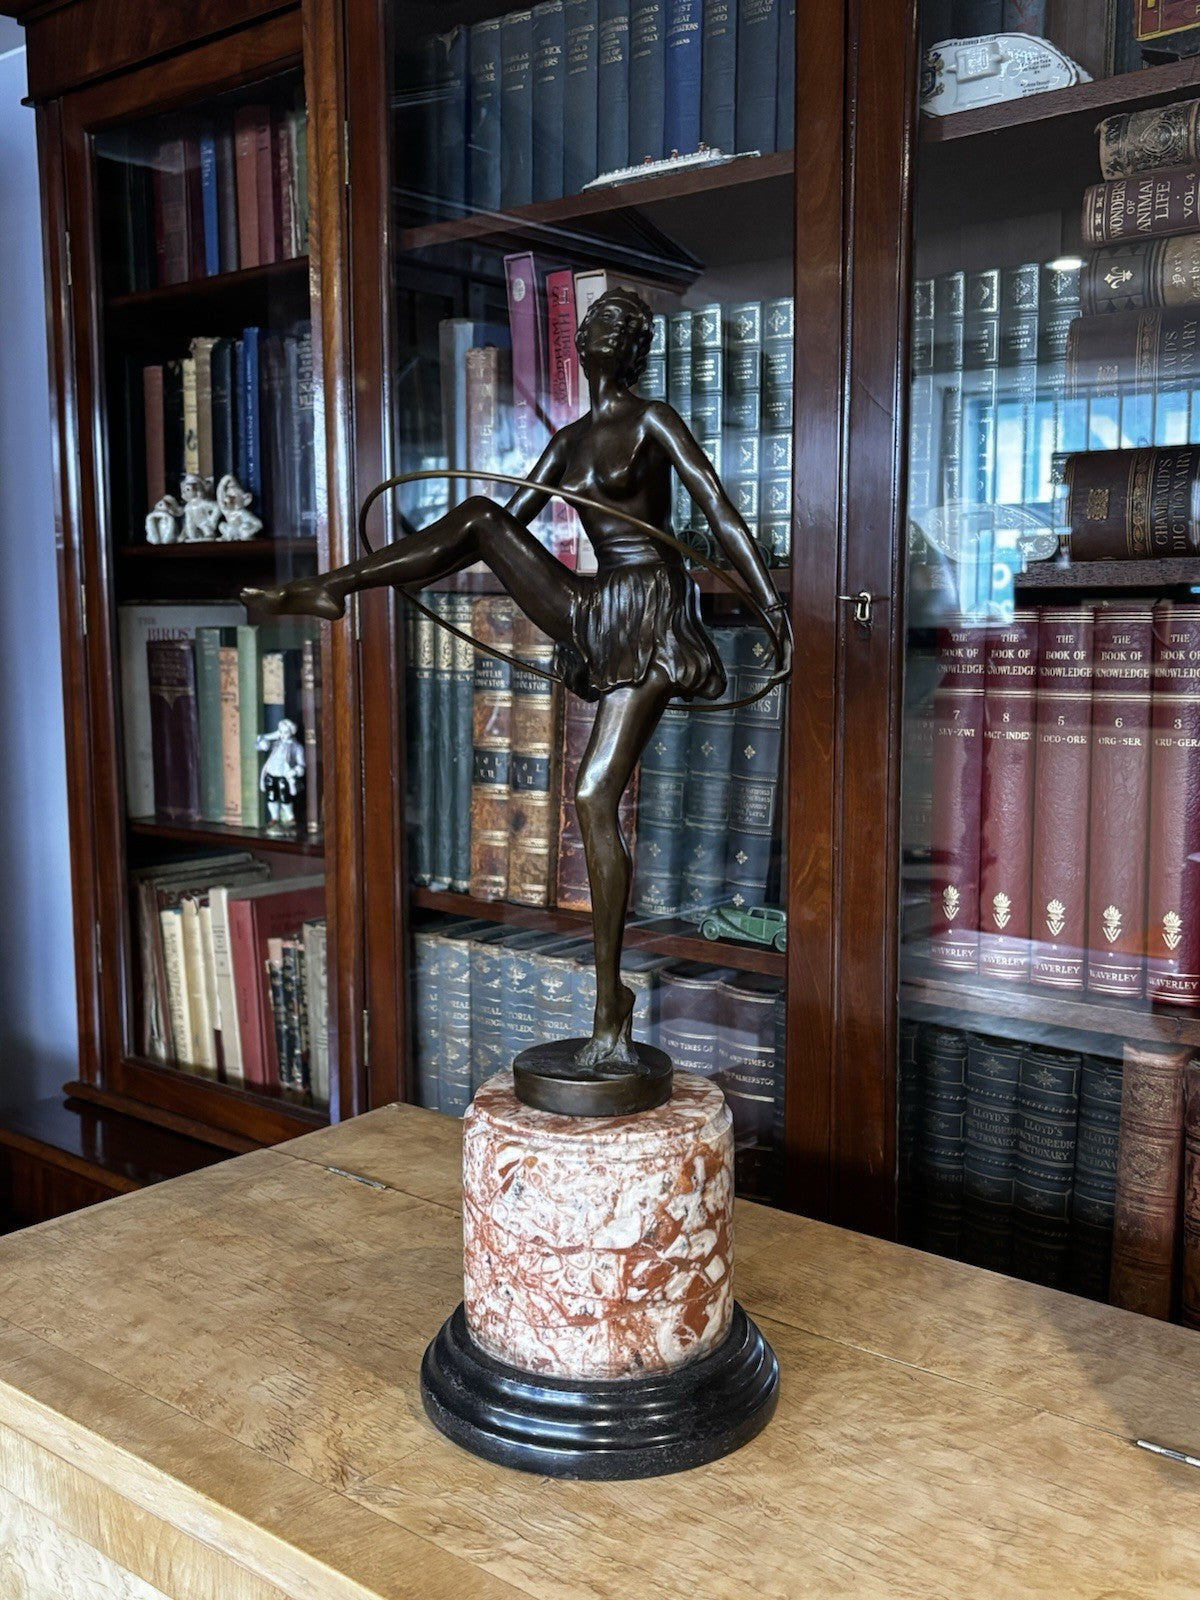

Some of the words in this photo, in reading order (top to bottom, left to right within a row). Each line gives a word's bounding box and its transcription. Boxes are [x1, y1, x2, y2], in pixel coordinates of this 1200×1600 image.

[1137, 176, 1154, 232] ANIMAL
[1155, 181, 1171, 220] LIFE
[1184, 182, 1195, 219] VOL.
[1110, 181, 1127, 238] WONDERS
[1127, 199, 1135, 214] OF
[1172, 452, 1192, 551] DICTIONARY
[952, 633, 968, 642] THE
[1001, 634, 1019, 642] THE
[1056, 634, 1075, 644] THE
[1112, 635, 1131, 645] THE
[1170, 634, 1190, 643] THE
[967, 649, 978, 659] OF
[1018, 649, 1031, 659] OF
[1045, 651, 1069, 660] BOOK
[1073, 651, 1086, 660] OF
[1101, 651, 1127, 661] BOOK
[1130, 651, 1143, 661] OF
[1160, 651, 1185, 660] BOOK
[1040, 667, 1092, 678] KNOWLEDGE
[1096, 668, 1150, 679] KNOWLEDGE
[1155, 668, 1200, 679] KNOWLEDG
[742, 699, 771, 713] ORKS
[953, 710, 960, 720] 7
[1002, 712, 1010, 722] 8
[1057, 716, 1065, 726] 5
[1115, 718, 1123, 728] 6
[1174, 719, 1182, 729] 3
[1098, 738, 1142, 746] ORG-SER
[1089, 969, 1138, 982] WAVERLEY
[1149, 977, 1198, 990] WAVERLEY
[681, 1042, 701, 1052] TIMES
[703, 1045, 713, 1053] OF
[672, 1059, 712, 1070] ALMERSTON
[744, 1059, 766, 1068] TIMES
[973, 1106, 1010, 1124] LLOYD'S
[1024, 1119, 1063, 1137] LLOYD'S
[1083, 1131, 1115, 1145] LLOYD
[1018, 1140, 1069, 1160] DICTIONARY
